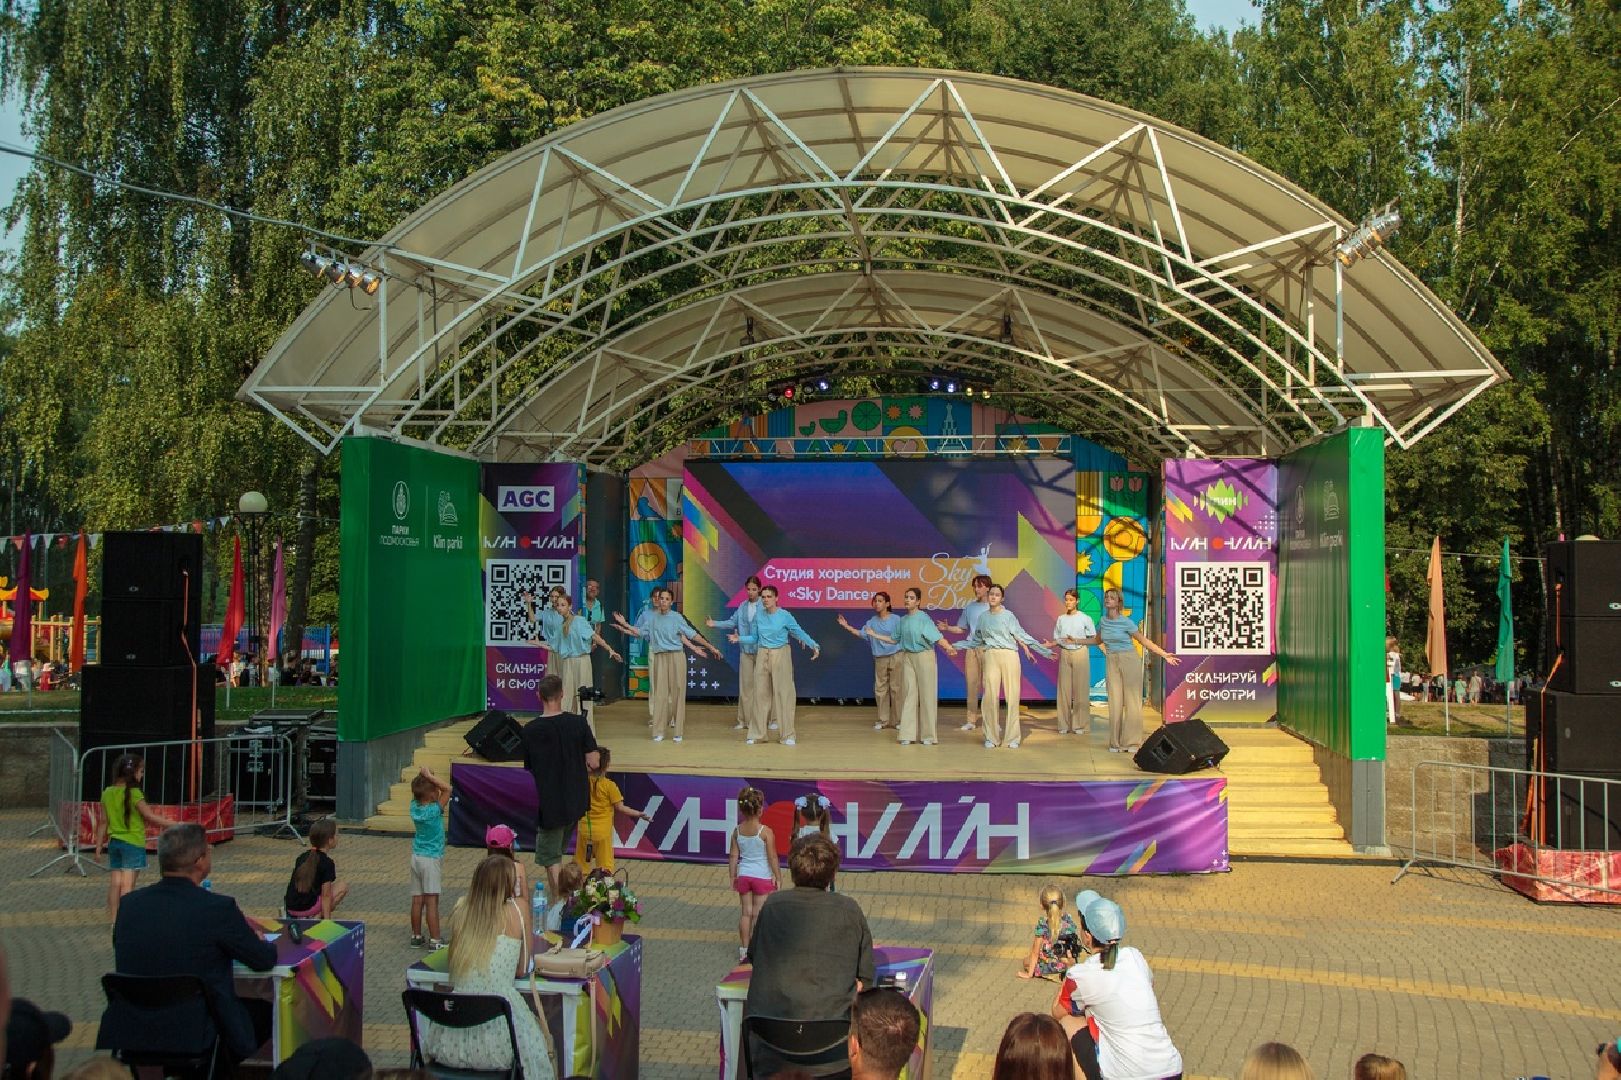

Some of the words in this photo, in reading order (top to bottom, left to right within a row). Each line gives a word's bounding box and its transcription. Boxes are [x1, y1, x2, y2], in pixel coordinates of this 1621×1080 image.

[502, 490, 551, 508] AGC
[764, 565, 814, 582] Студия
[818, 564, 911, 583] хореографии
[919, 552, 973, 593] Sky
[496, 678, 506, 689] И
[1185, 670, 1257, 684] СКАНИРУЙ
[1186, 689, 1196, 701] И
[1199, 689, 1256, 701] СМОТРИ
